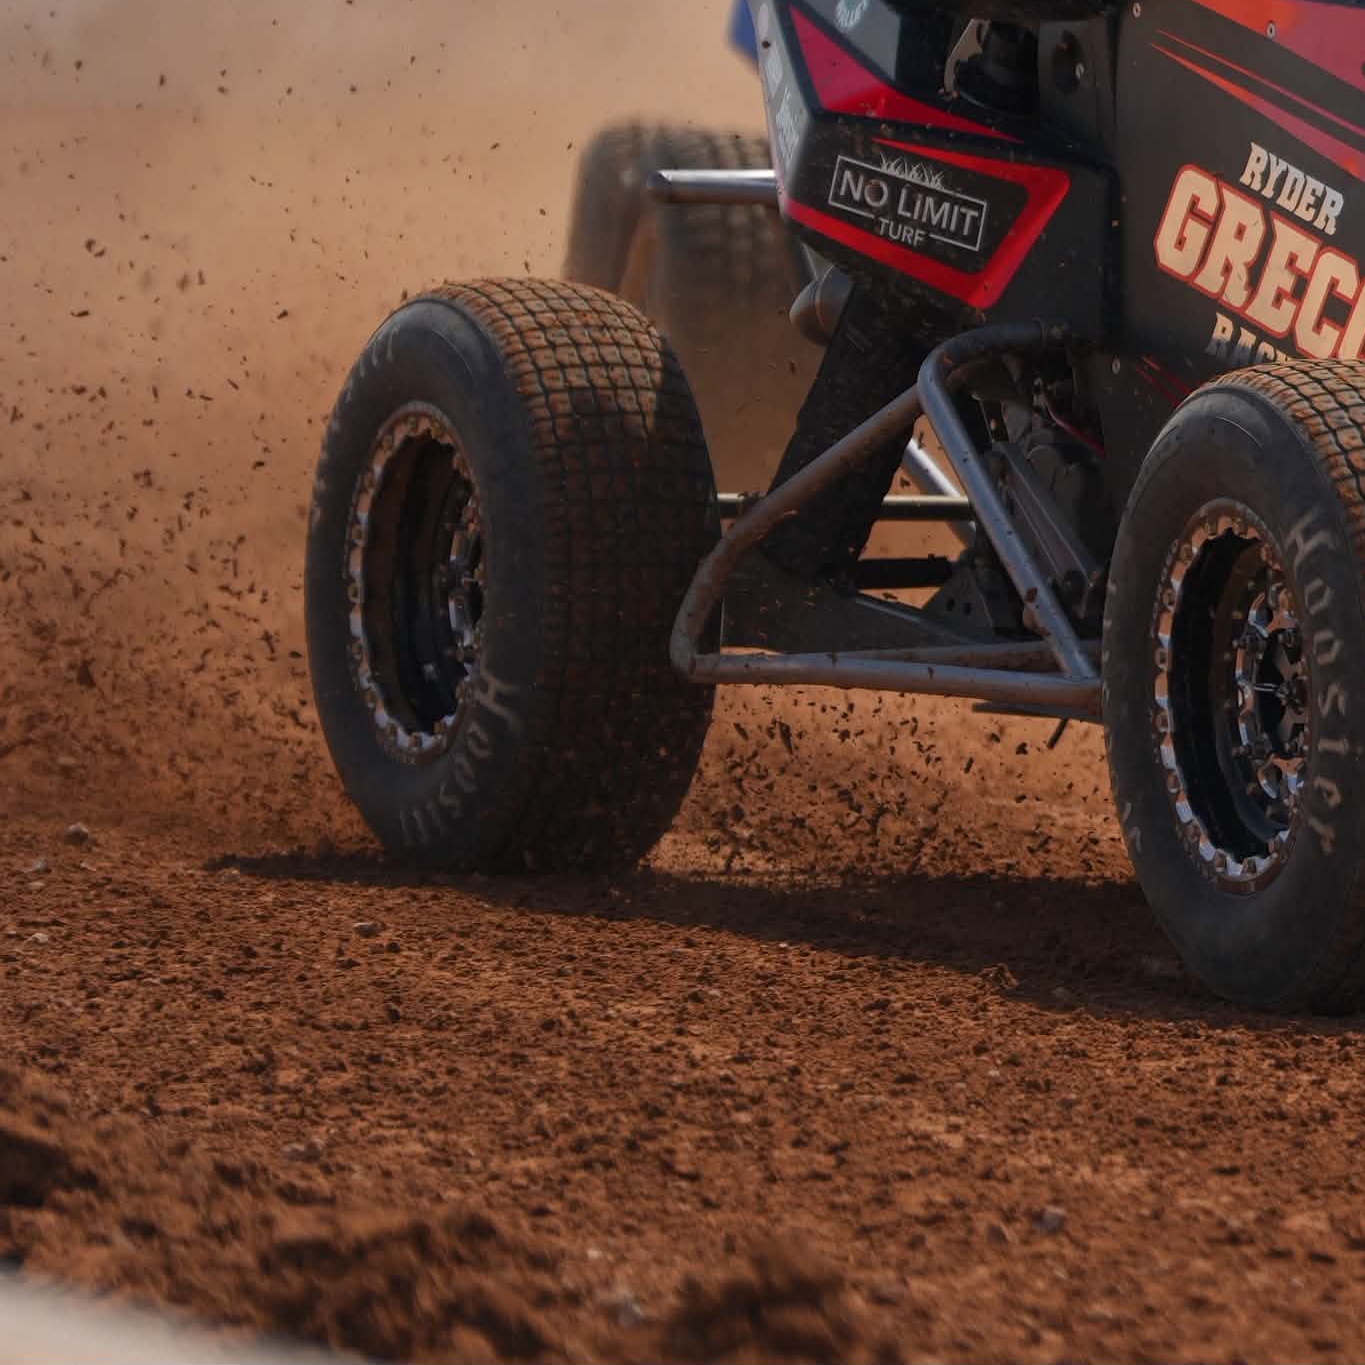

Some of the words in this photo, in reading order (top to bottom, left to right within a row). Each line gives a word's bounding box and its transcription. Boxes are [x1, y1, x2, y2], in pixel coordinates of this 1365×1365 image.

[839, 170, 888, 208] NO
[1240, 142, 1344, 235] RYDER
[877, 217, 928, 247] TURF
